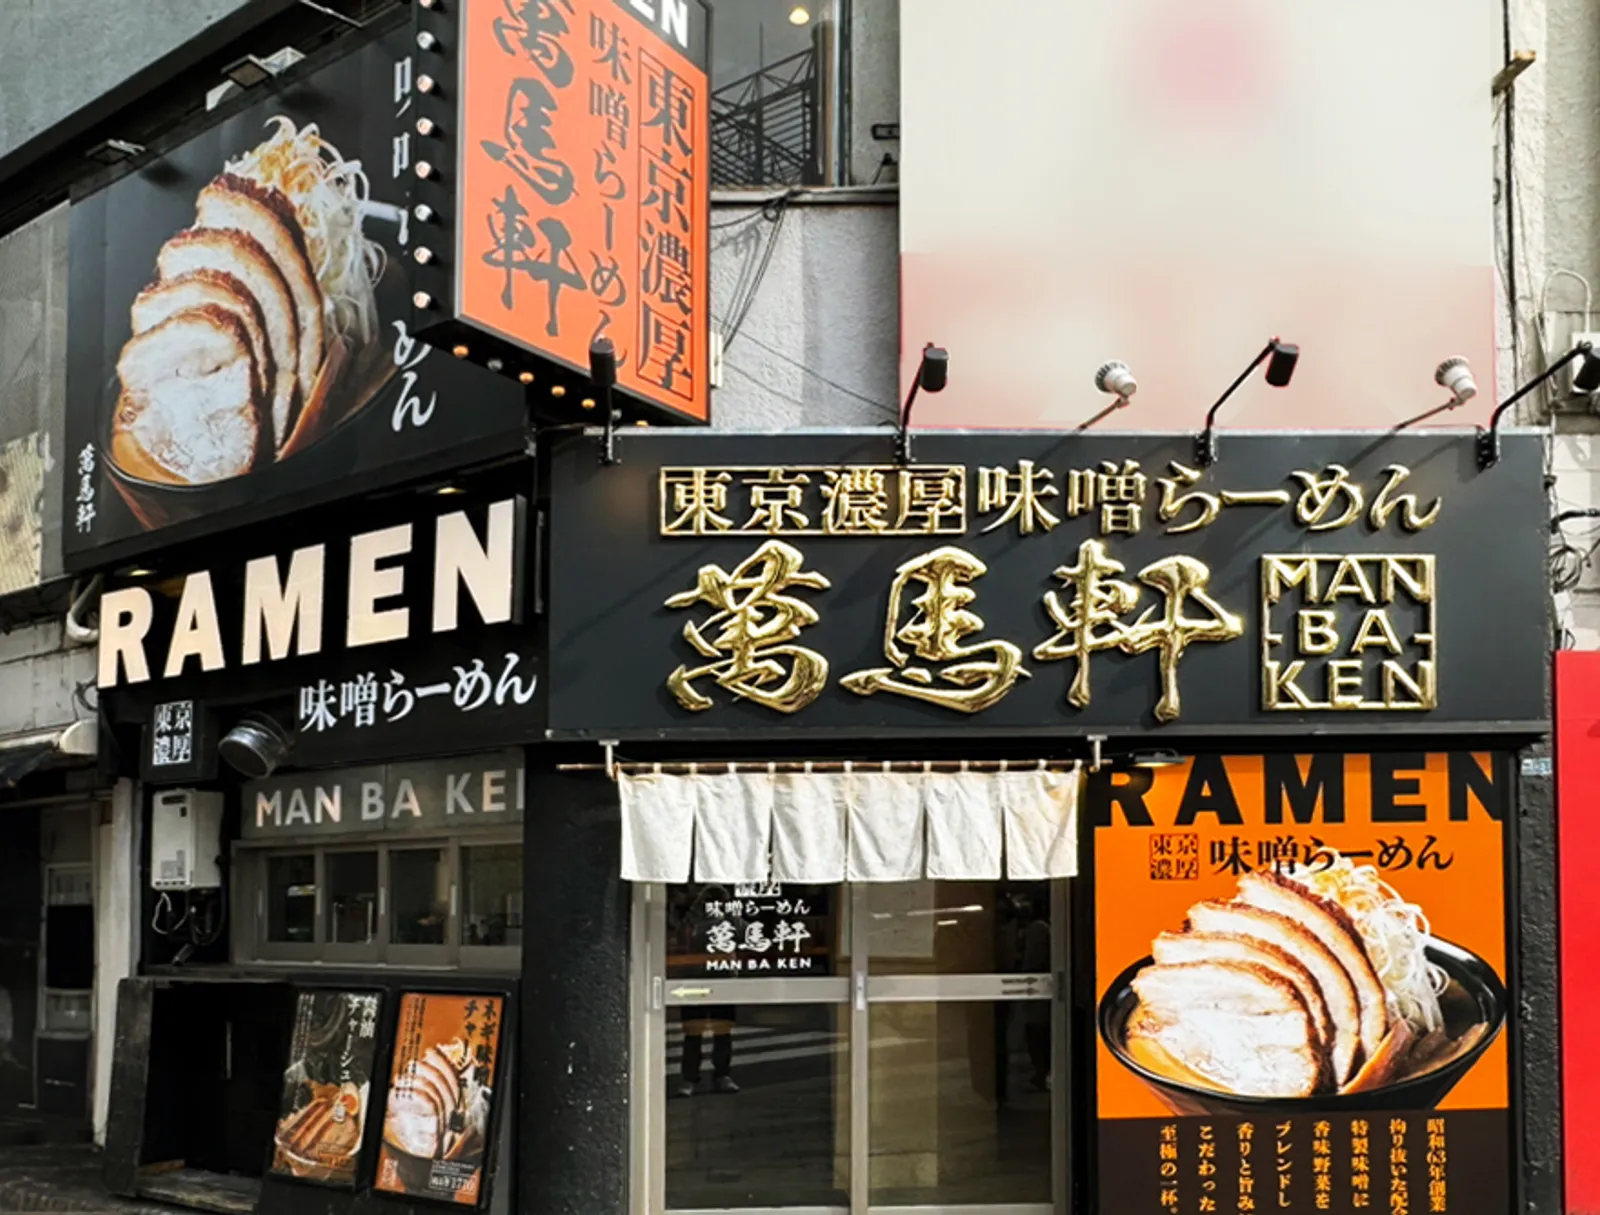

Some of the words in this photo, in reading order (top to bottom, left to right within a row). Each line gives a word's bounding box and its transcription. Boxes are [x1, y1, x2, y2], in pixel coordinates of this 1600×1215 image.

[639, 66, 695, 392] 東京濃厚
[662, 467, 966, 534] 東京濃厚
[978, 459, 1443, 534] 味噌らーめん
[98, 498, 515, 689] RAMEN
[1266, 556, 1434, 602] MAN
[664, 539, 1244, 723] 萬馬軒
[1299, 609, 1403, 655] BA
[300, 651, 537, 733] 味噌らーめん
[1264, 659, 1434, 706] KEN
[256, 784, 342, 828] MAN
[361, 778, 423, 820] BA
[445, 767, 525, 815] KE
[1093, 752, 1502, 827] RAMEN
[1210, 834, 1454, 876] 味噌らーめん
[704, 899, 812, 918] 味噌らーめん
[706, 919, 812, 954] 萬馬軒
[706, 959, 743, 971] MAN
[748, 959, 771, 970] BA
[777, 957, 812, 969] KEN
[1198, 1125, 1217, 1212] こだわった
[1275, 1120, 1293, 1207] ブレンドし
[1312, 1120, 1332, 1209] 香味野菜を
[1351, 1120, 1370, 1207] 特製味噌に
